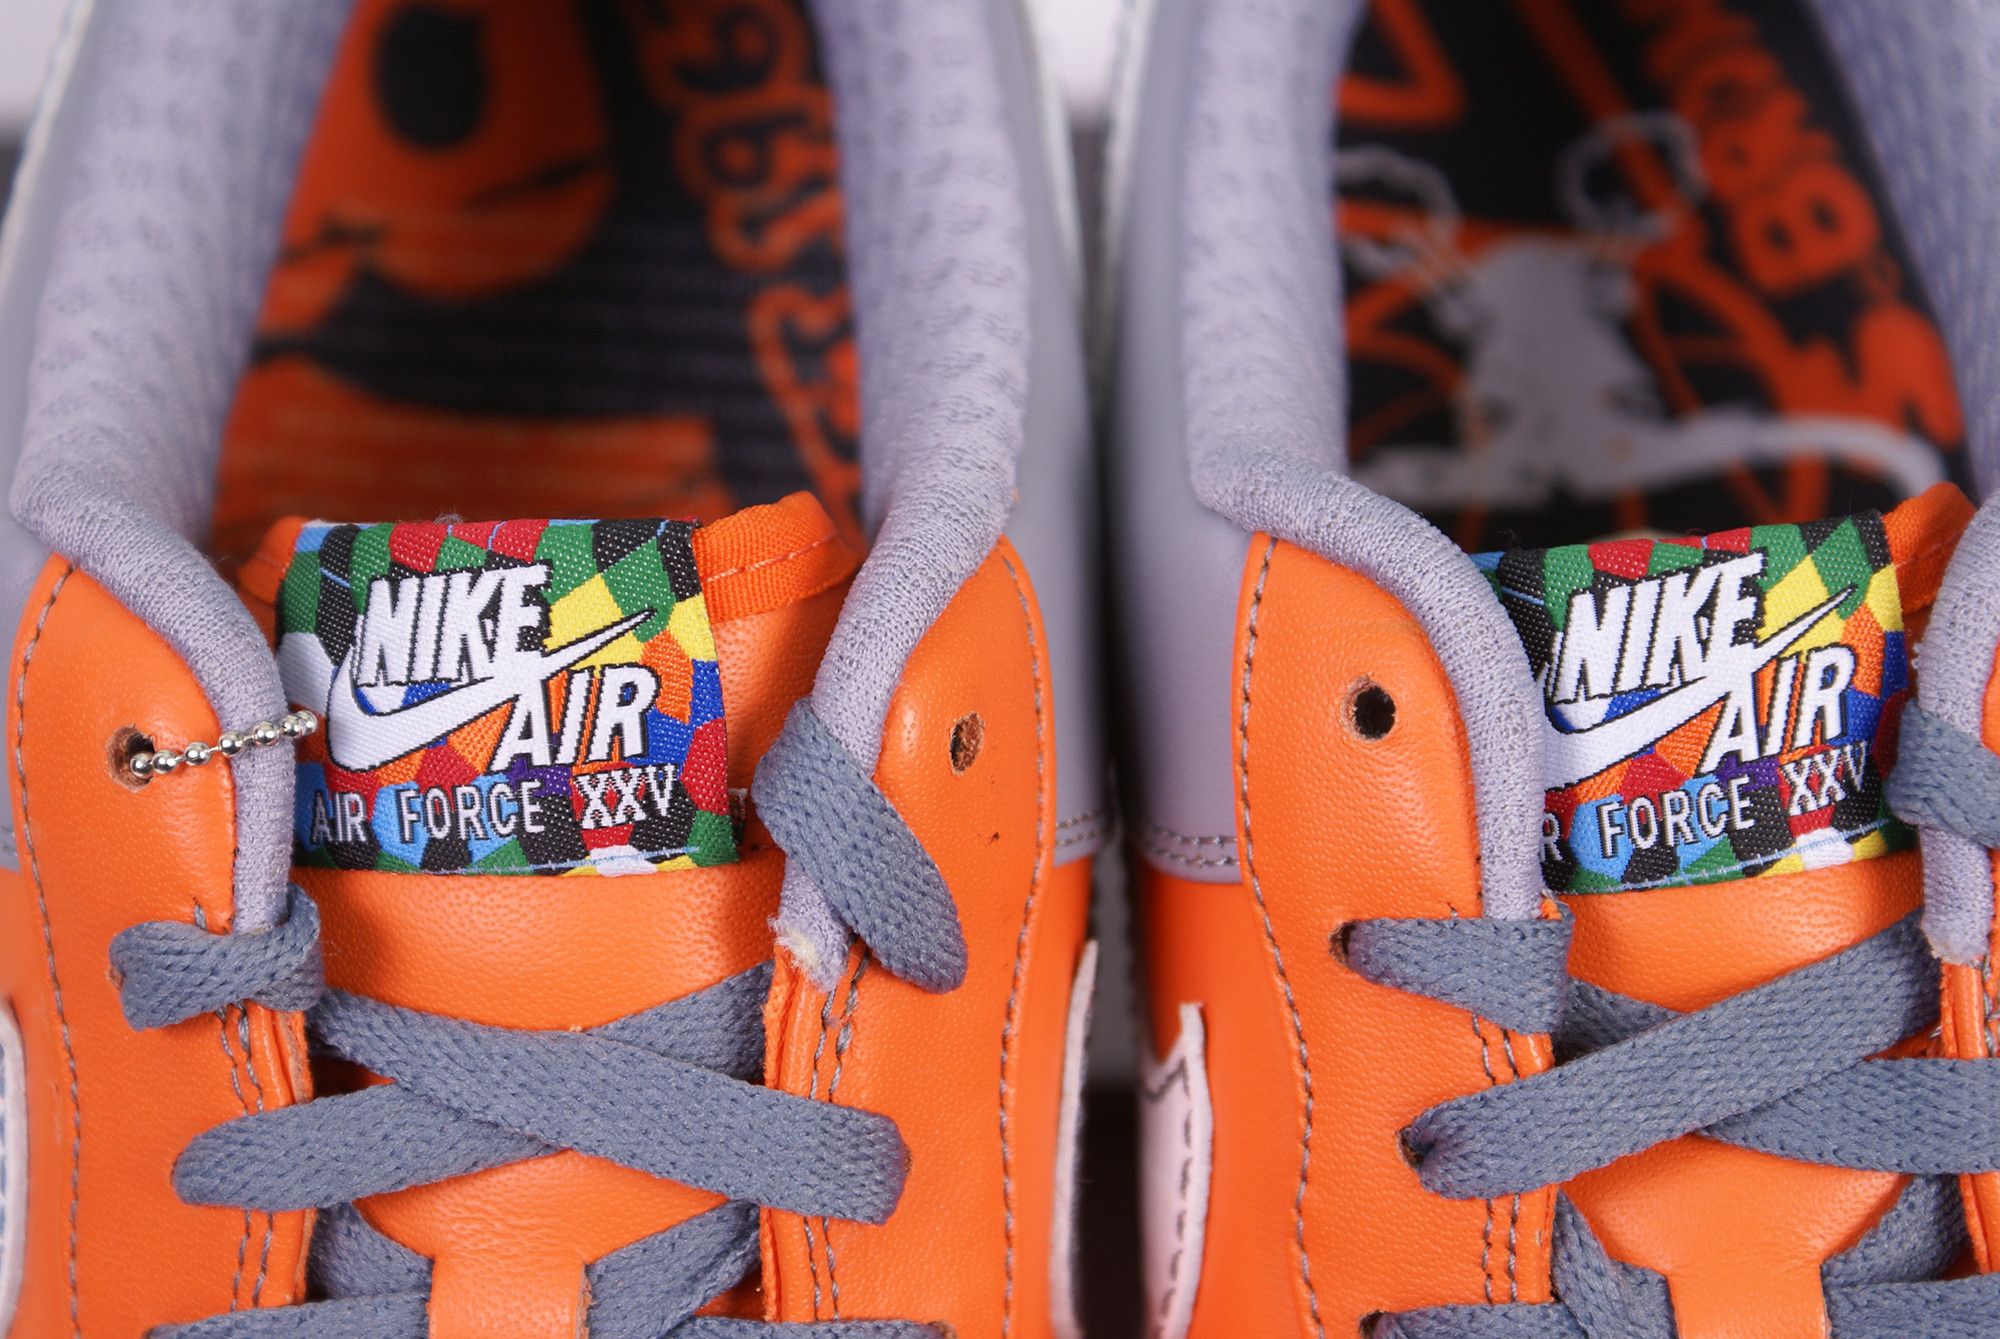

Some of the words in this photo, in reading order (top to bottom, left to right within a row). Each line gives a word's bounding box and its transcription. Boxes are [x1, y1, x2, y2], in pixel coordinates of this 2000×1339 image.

[355, 562, 552, 686] NIKE
[1548, 552, 1768, 704] NIKE
[490, 664, 660, 772] AIR
[1698, 642, 1856, 776] AIR
[311, 788, 368, 844] AIR
[400, 778, 547, 843] FORCE
[573, 764, 680, 830] XXV
[1599, 775, 1757, 859] FORCE
[1780, 740, 1869, 818] XXV
